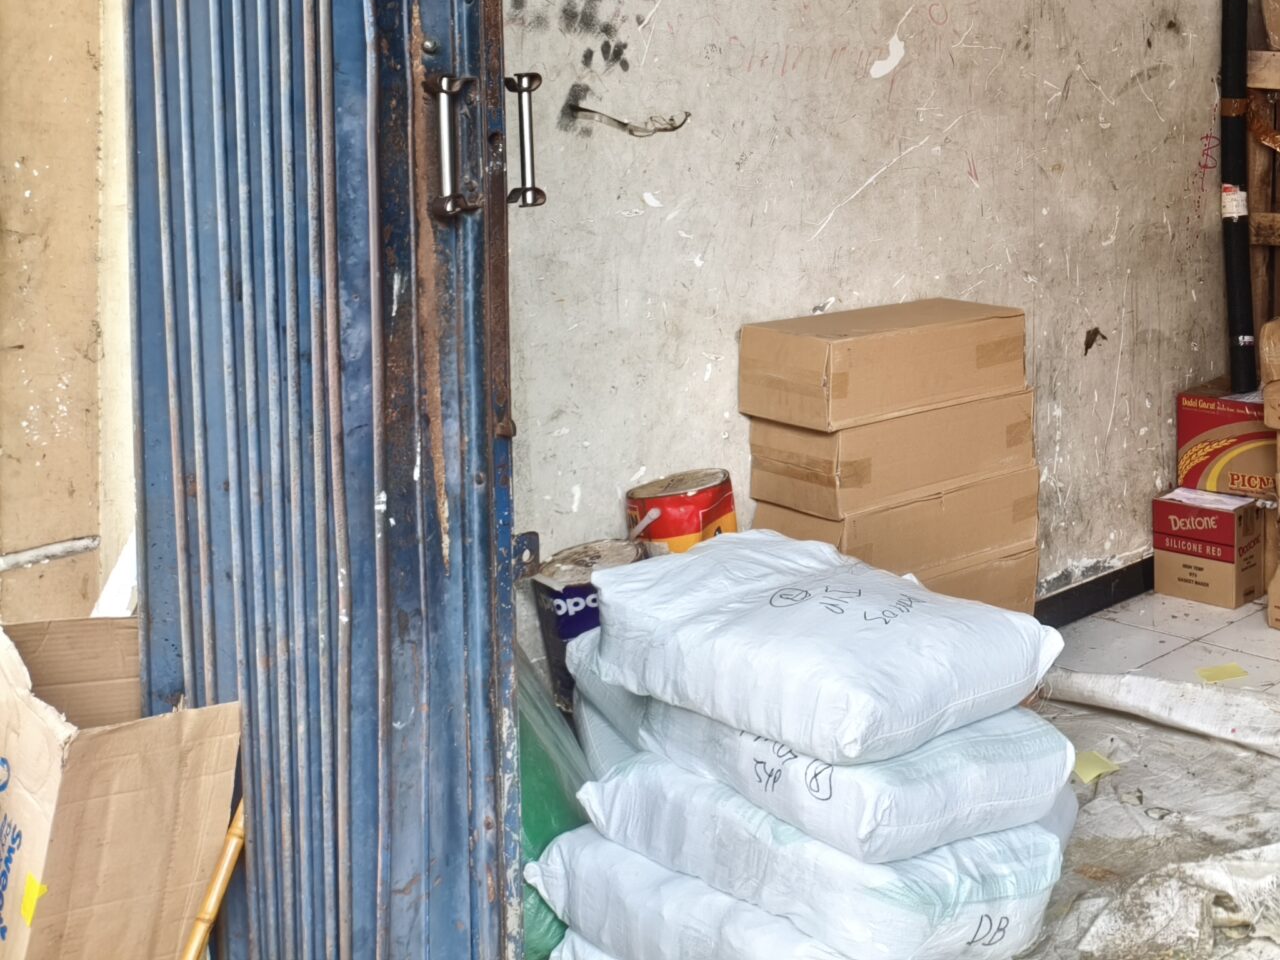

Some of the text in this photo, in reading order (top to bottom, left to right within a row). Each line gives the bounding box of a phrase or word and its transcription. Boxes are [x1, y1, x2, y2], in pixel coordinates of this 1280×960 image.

[1164, 537, 1223, 557] SILICONE RED
[965, 913, 1010, 947] DB
